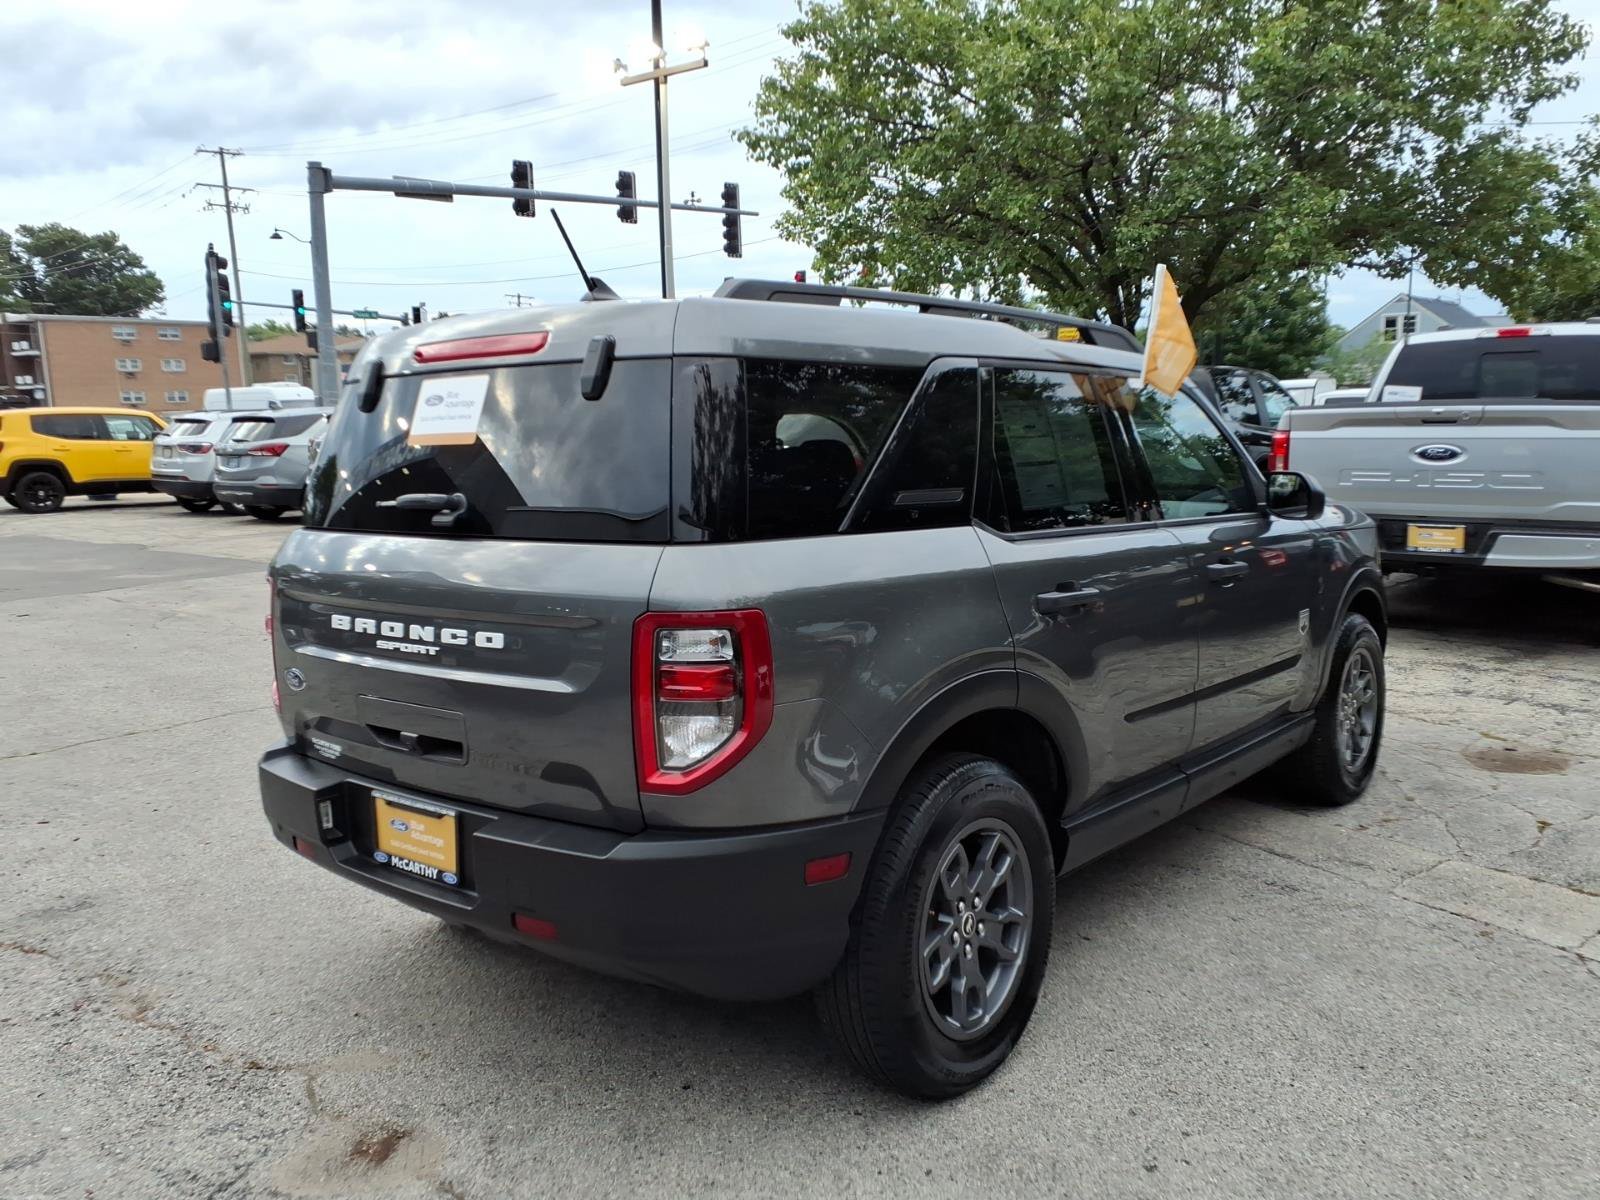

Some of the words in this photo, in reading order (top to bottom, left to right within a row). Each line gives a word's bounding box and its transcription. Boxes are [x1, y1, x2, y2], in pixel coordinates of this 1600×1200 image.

[331, 614, 504, 649] BRONCO
[376, 640, 440, 655] SPORT
[391, 855, 438, 879] McCARTHY
